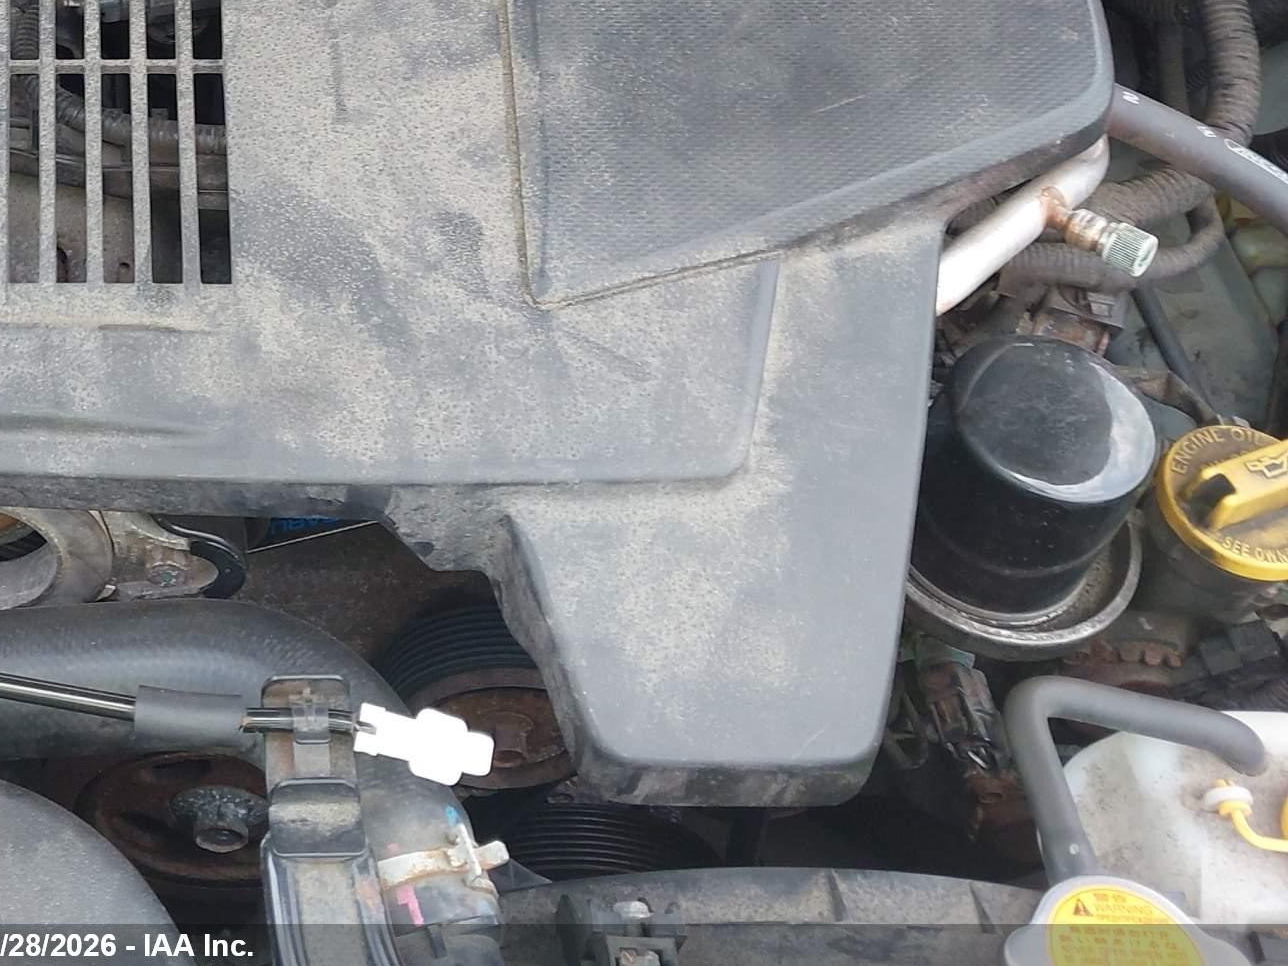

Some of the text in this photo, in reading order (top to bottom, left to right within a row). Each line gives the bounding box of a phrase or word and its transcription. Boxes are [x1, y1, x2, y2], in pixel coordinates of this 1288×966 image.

[1171, 428, 1225, 474] ENGINE
[1230, 427, 1264, 445] OIL
[1222, 536, 1251, 558] SEE
